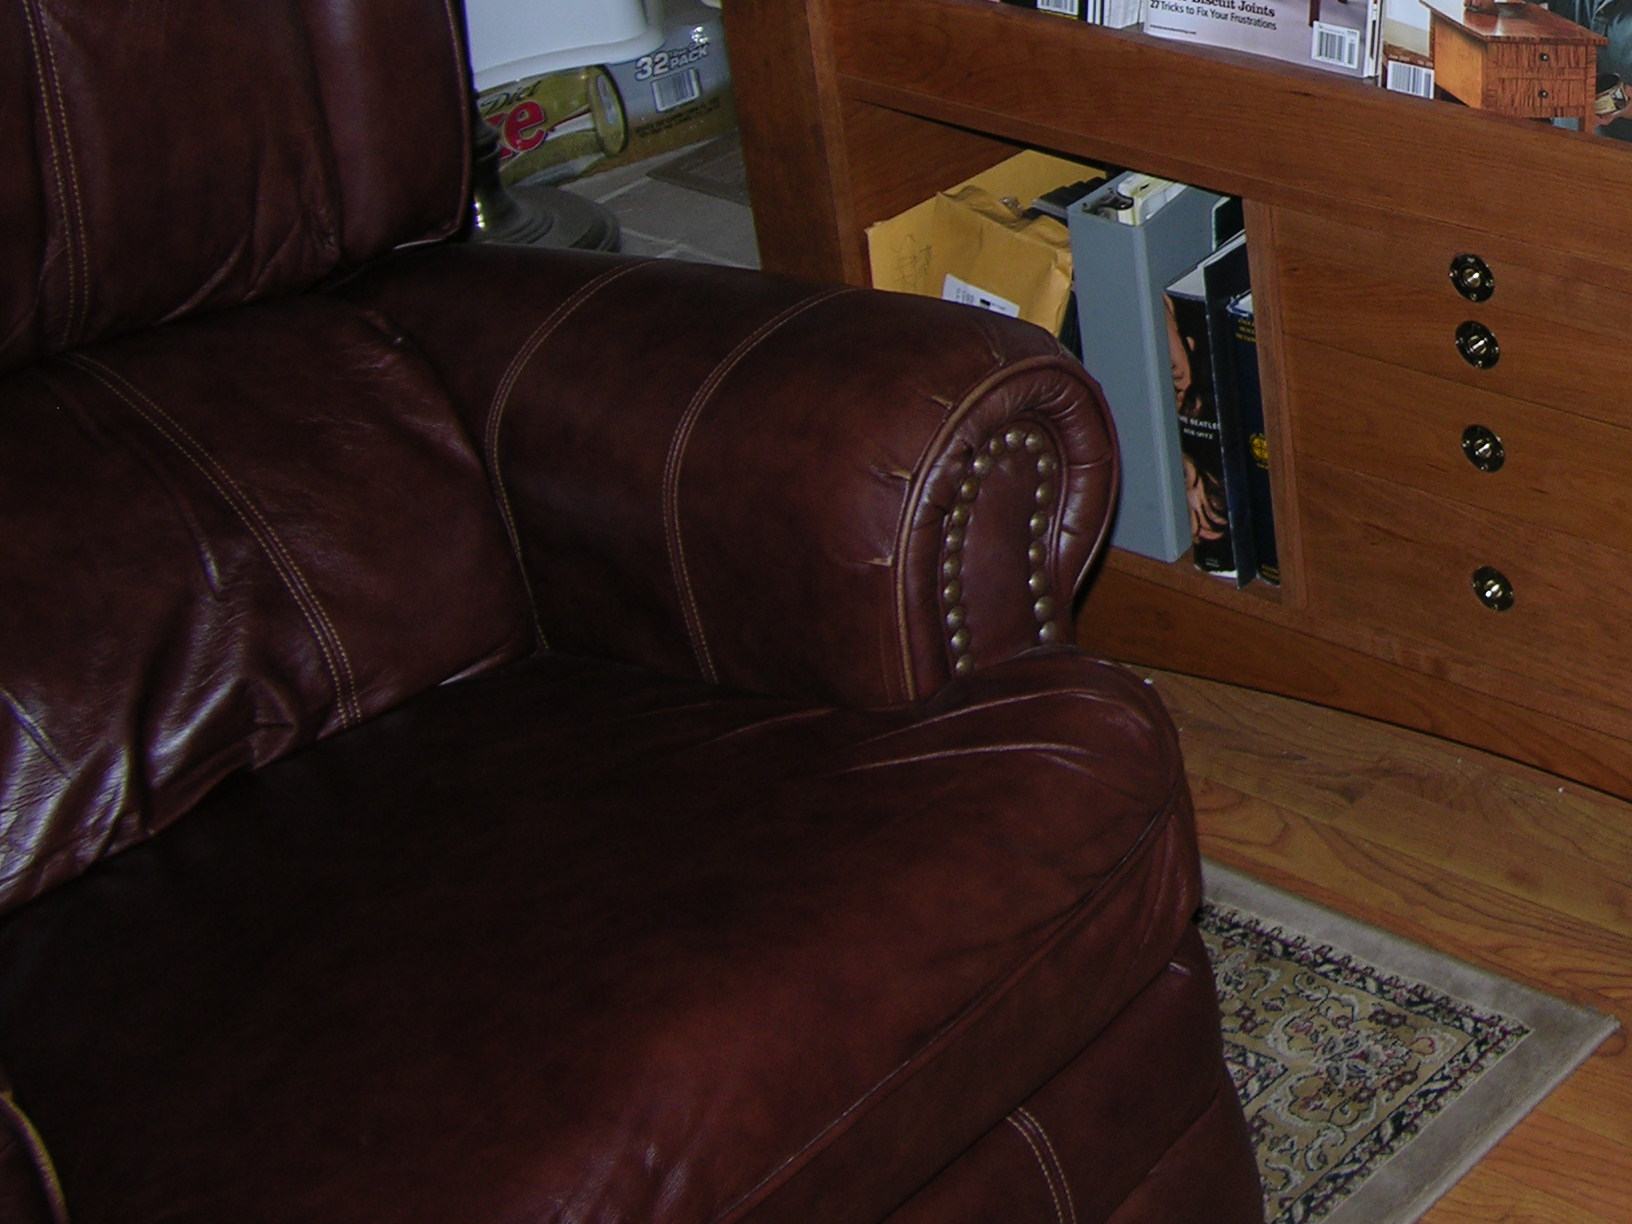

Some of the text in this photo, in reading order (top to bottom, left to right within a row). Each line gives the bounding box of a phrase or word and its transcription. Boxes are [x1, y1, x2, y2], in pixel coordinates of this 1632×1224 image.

[1238, 0, 1275, 17] Joints
[635, 46, 708, 81] 32 PACK
[480, 80, 541, 112] Diet
[1190, 418, 1221, 430] BEATLES
